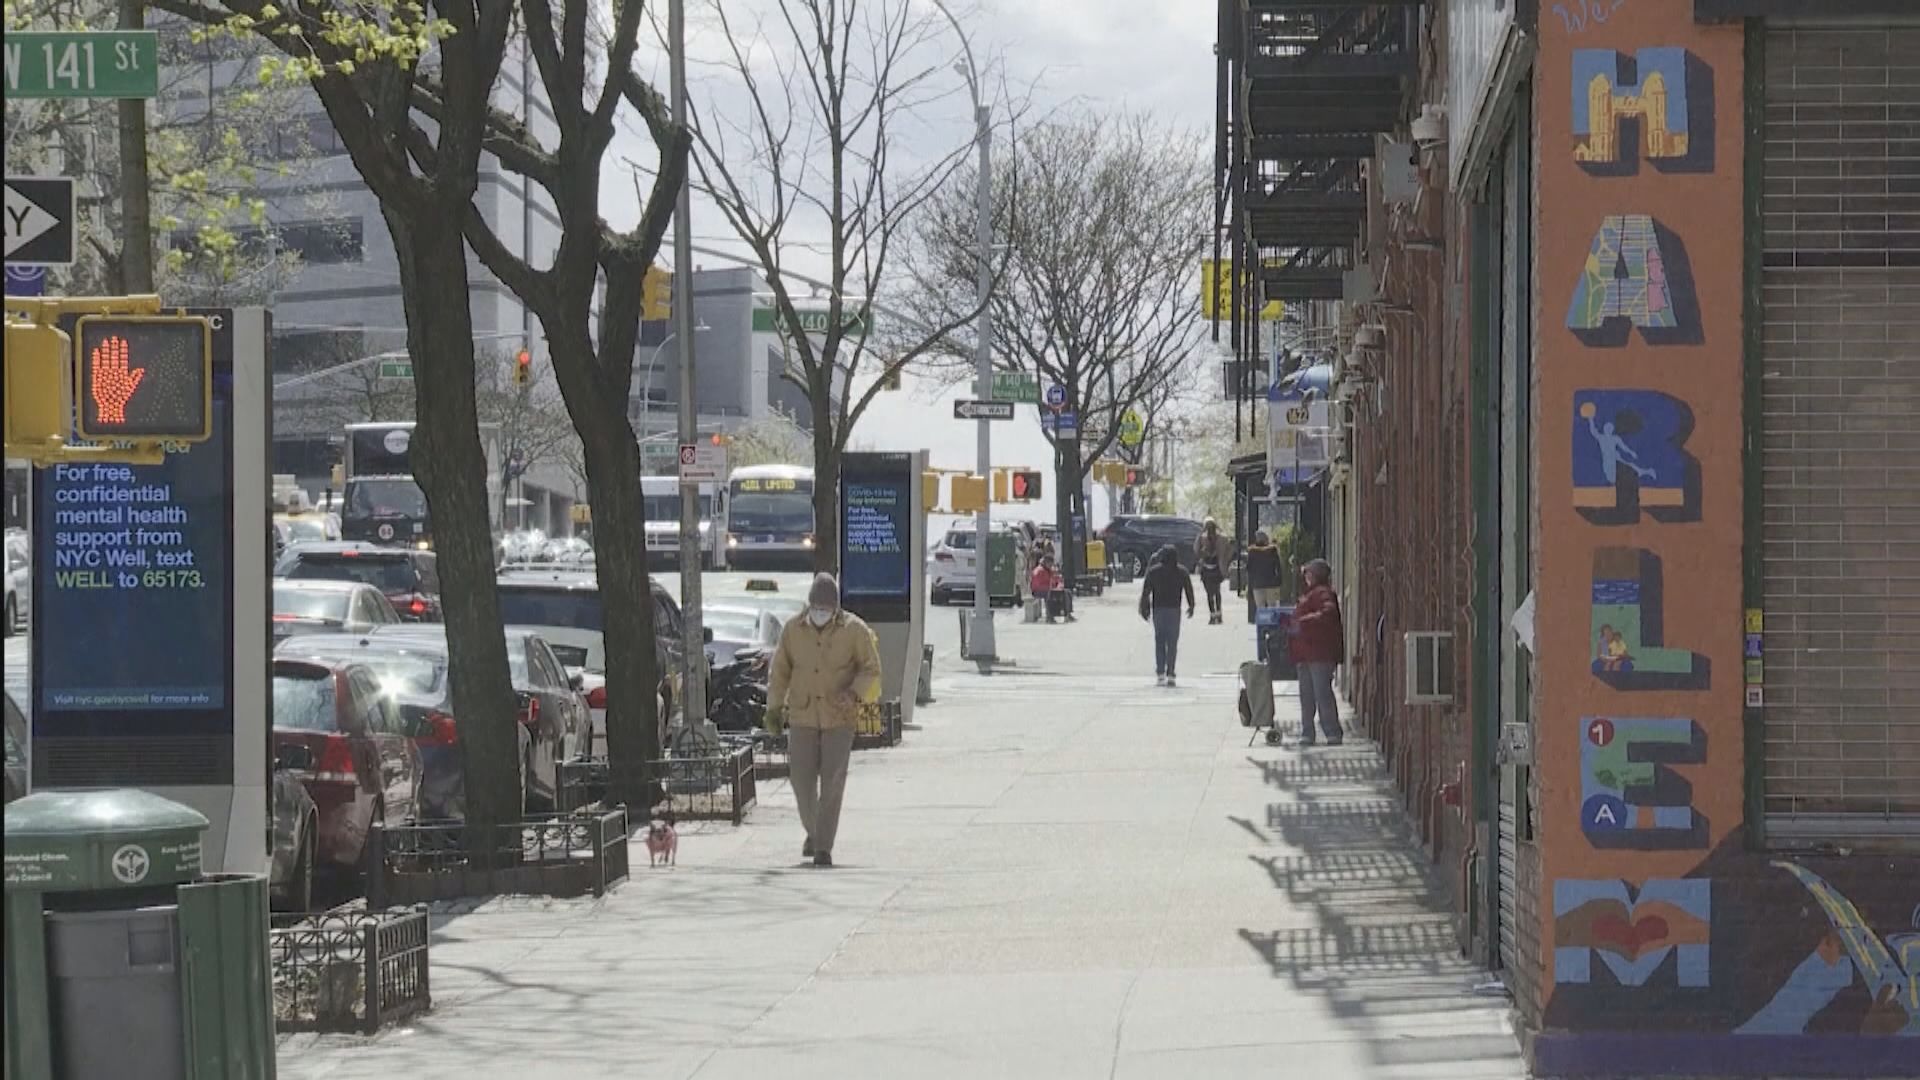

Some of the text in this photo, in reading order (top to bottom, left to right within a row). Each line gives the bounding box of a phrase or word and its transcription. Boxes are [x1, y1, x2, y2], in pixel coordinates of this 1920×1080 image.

[42, 42, 95, 89] 141
[115, 40, 139, 70] St
[56, 464, 136, 484] For free,
[55, 484, 170, 502] confidential
[56, 506, 187, 524] mental health
[1554, 47, 1714, 988] HARLEM
[55, 528, 182, 549] support from
[56, 550, 193, 569] NYC Well, text
[56, 571, 205, 588] WELL to 65173.
[1591, 724, 1604, 745] 1
[1594, 803, 1617, 825] A
